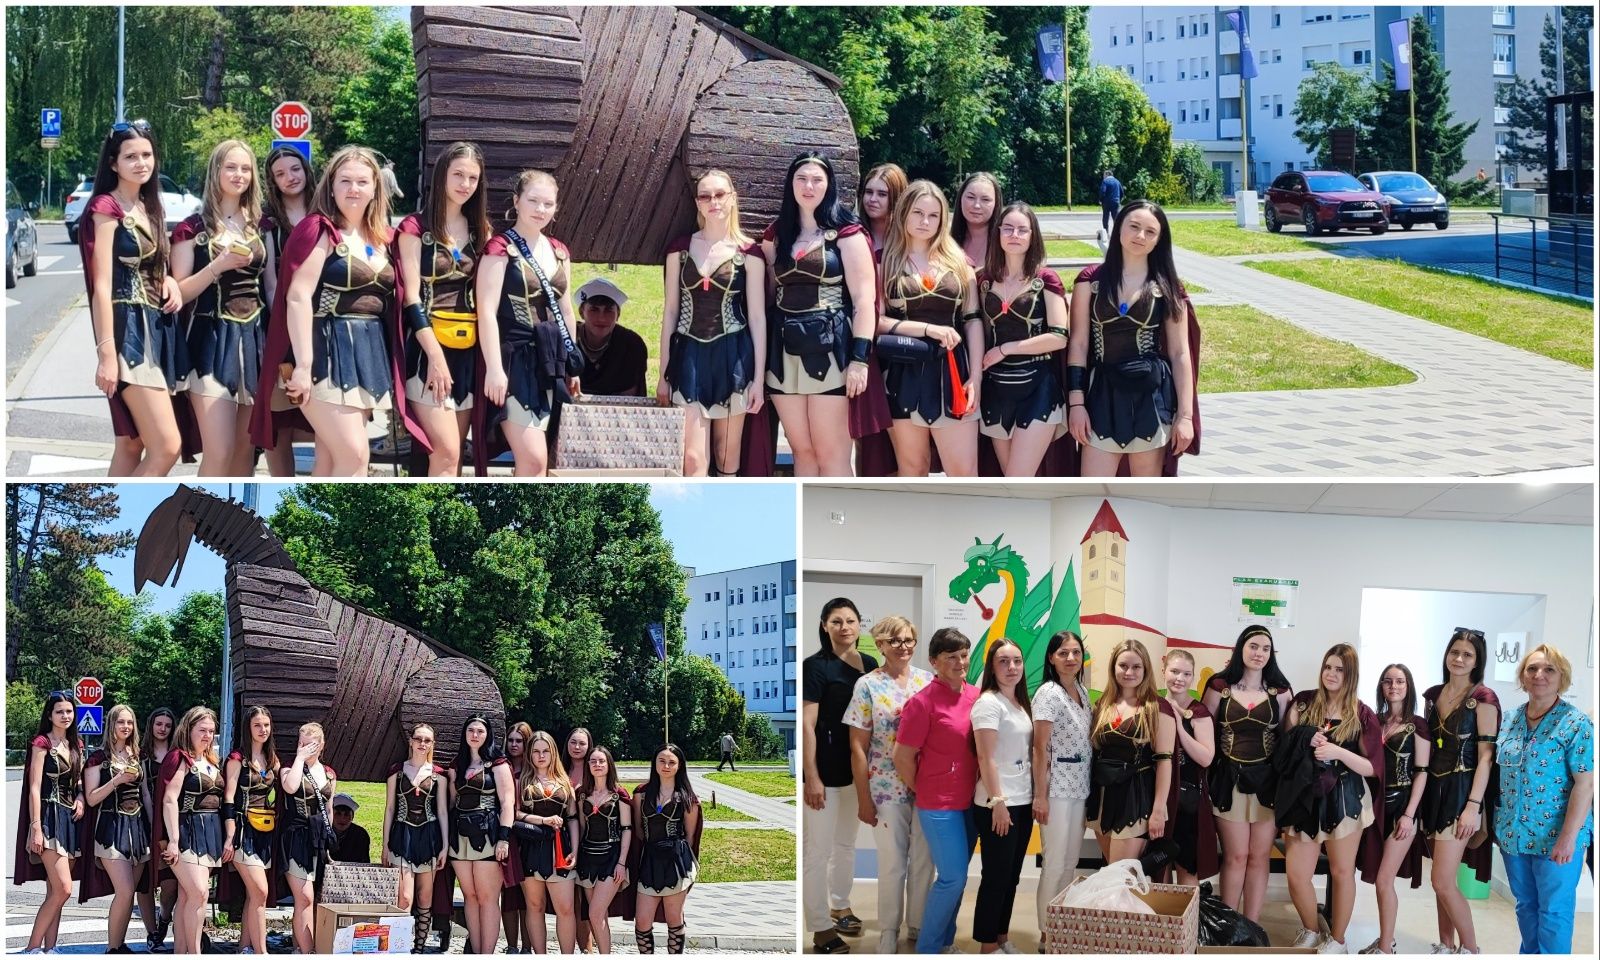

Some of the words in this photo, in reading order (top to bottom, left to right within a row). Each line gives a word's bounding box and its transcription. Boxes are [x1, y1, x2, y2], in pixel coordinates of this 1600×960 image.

[46, 111, 56, 124] P
[275, 113, 308, 129] STOP
[528, 258, 545, 280] HUGO
[555, 314, 570, 338] HUGO
[76, 686, 101, 698] STOP
